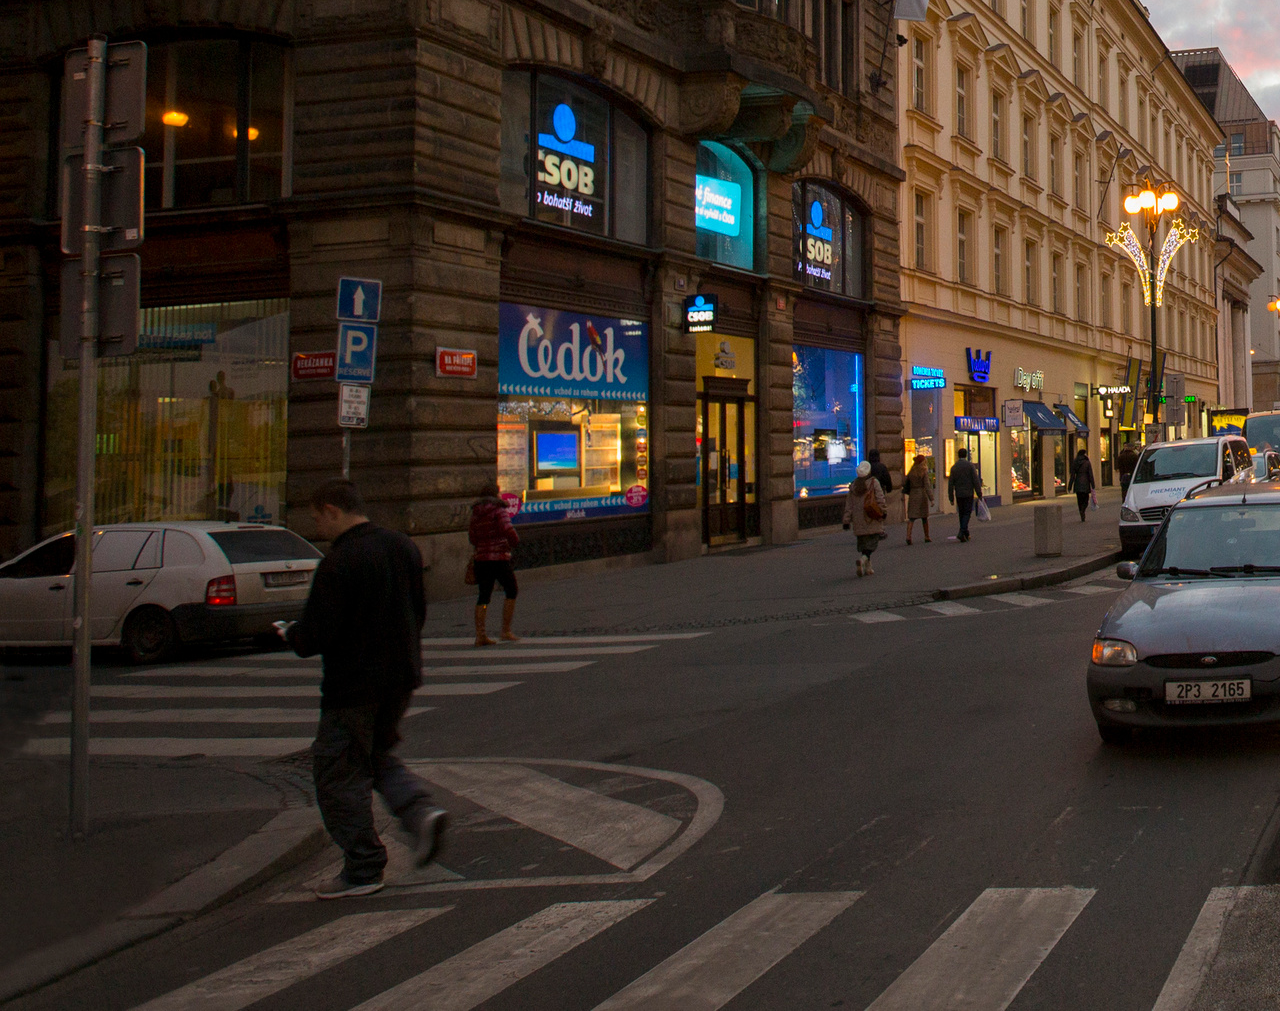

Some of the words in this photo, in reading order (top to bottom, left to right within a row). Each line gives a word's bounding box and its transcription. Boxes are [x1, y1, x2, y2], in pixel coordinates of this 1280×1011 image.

[702, 187, 732, 210] finance
[573, 200, 593, 218] život
[799, 237, 832, 265] SOB
[345, 329, 369, 364] P
[518, 312, 628, 385] Čedok
[554, 386, 572, 396] vchod
[580, 388, 599, 397] rohem
[911, 378, 945, 389] TICKETS
[1107, 385, 1131, 394] HALADA
[1150, 486, 1186, 495] PREMIANT
[554, 501, 572, 510] vchod
[580, 499, 599, 508] rohem
[1176, 683, 1201, 699] 2P3
[1211, 681, 1245, 698] 2165
